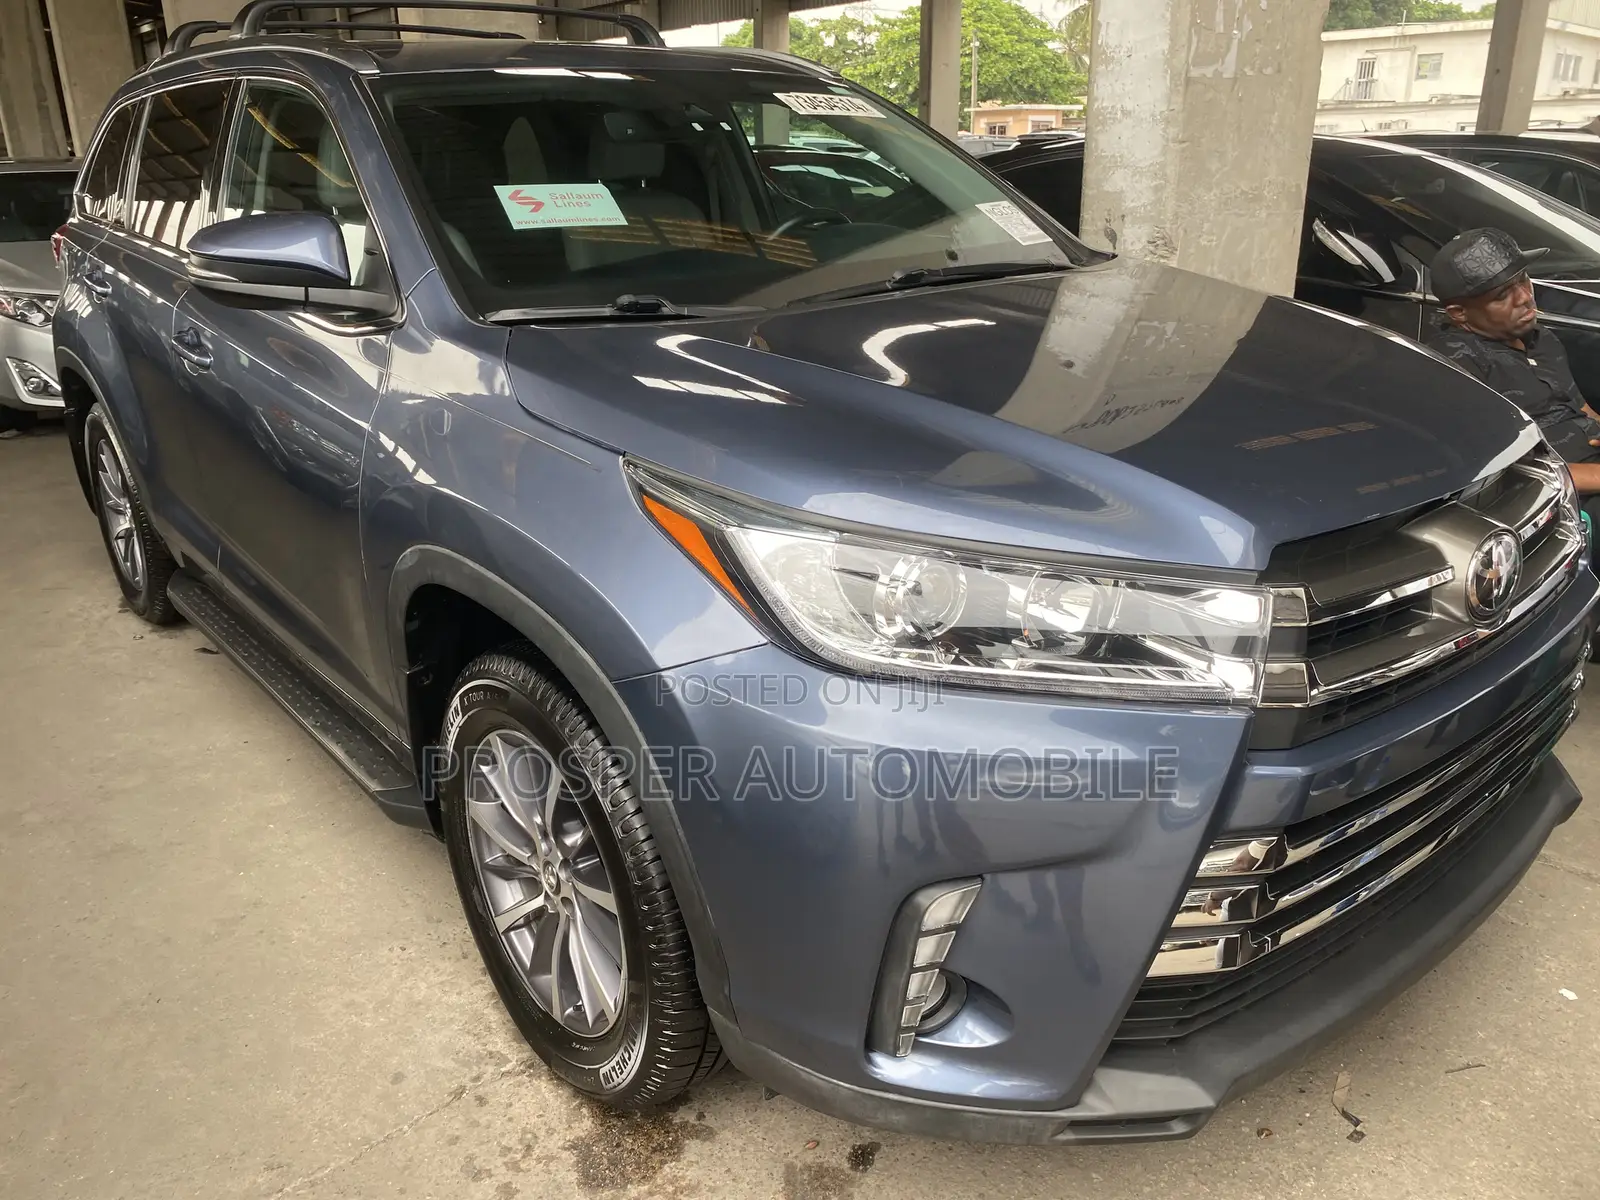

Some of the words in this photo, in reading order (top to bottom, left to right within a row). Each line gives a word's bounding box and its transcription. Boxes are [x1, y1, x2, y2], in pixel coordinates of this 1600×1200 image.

[548, 192, 604, 201] Sallaum
[553, 200, 592, 208] Lines
[515, 216, 621, 225] www.sallaumlines.com
